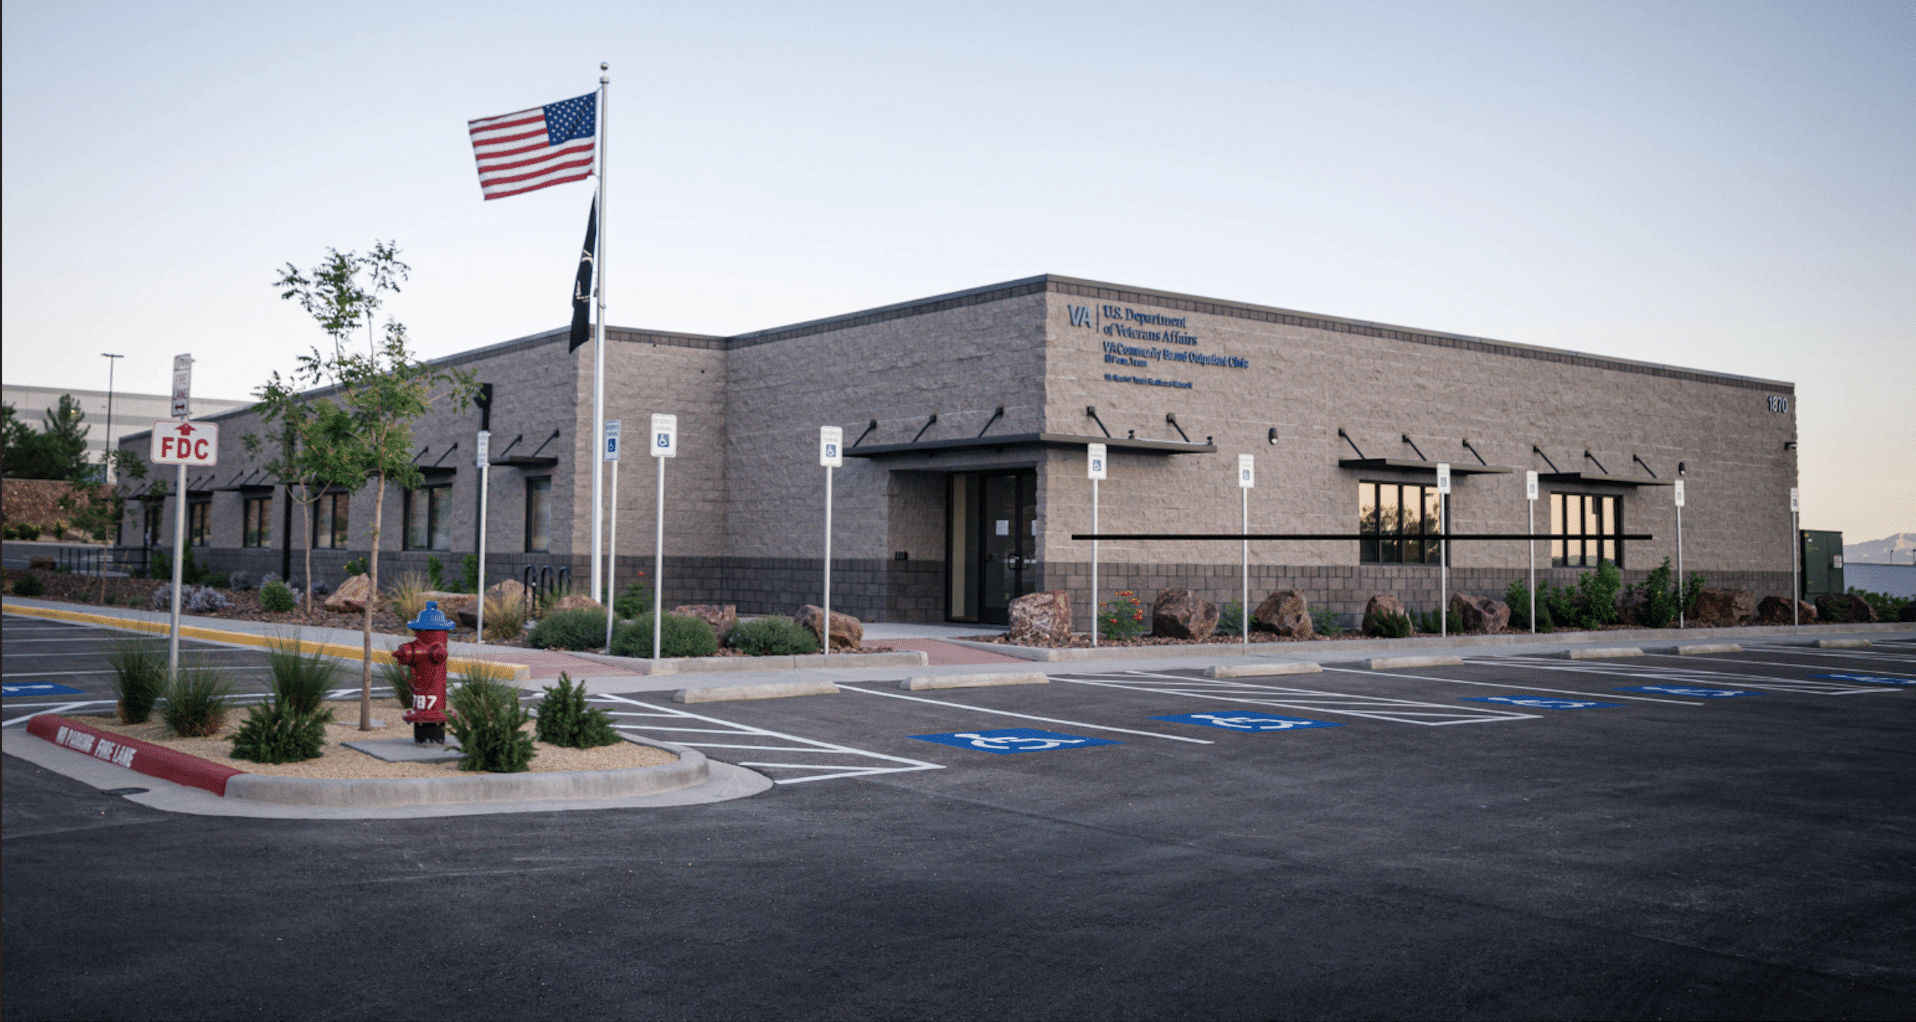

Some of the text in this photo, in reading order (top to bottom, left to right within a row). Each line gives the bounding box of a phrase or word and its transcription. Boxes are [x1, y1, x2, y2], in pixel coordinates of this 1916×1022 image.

[1068, 304, 1092, 329] VA
[1103, 305, 1186, 328] U.S. Department
[1103, 322, 1198, 345] of Veterans Affairs
[1767, 395, 1789, 414] 1870
[161, 436, 209, 460] FDC
[94, 739, 116, 760] FIRE
[112, 744, 137, 768] LANE
